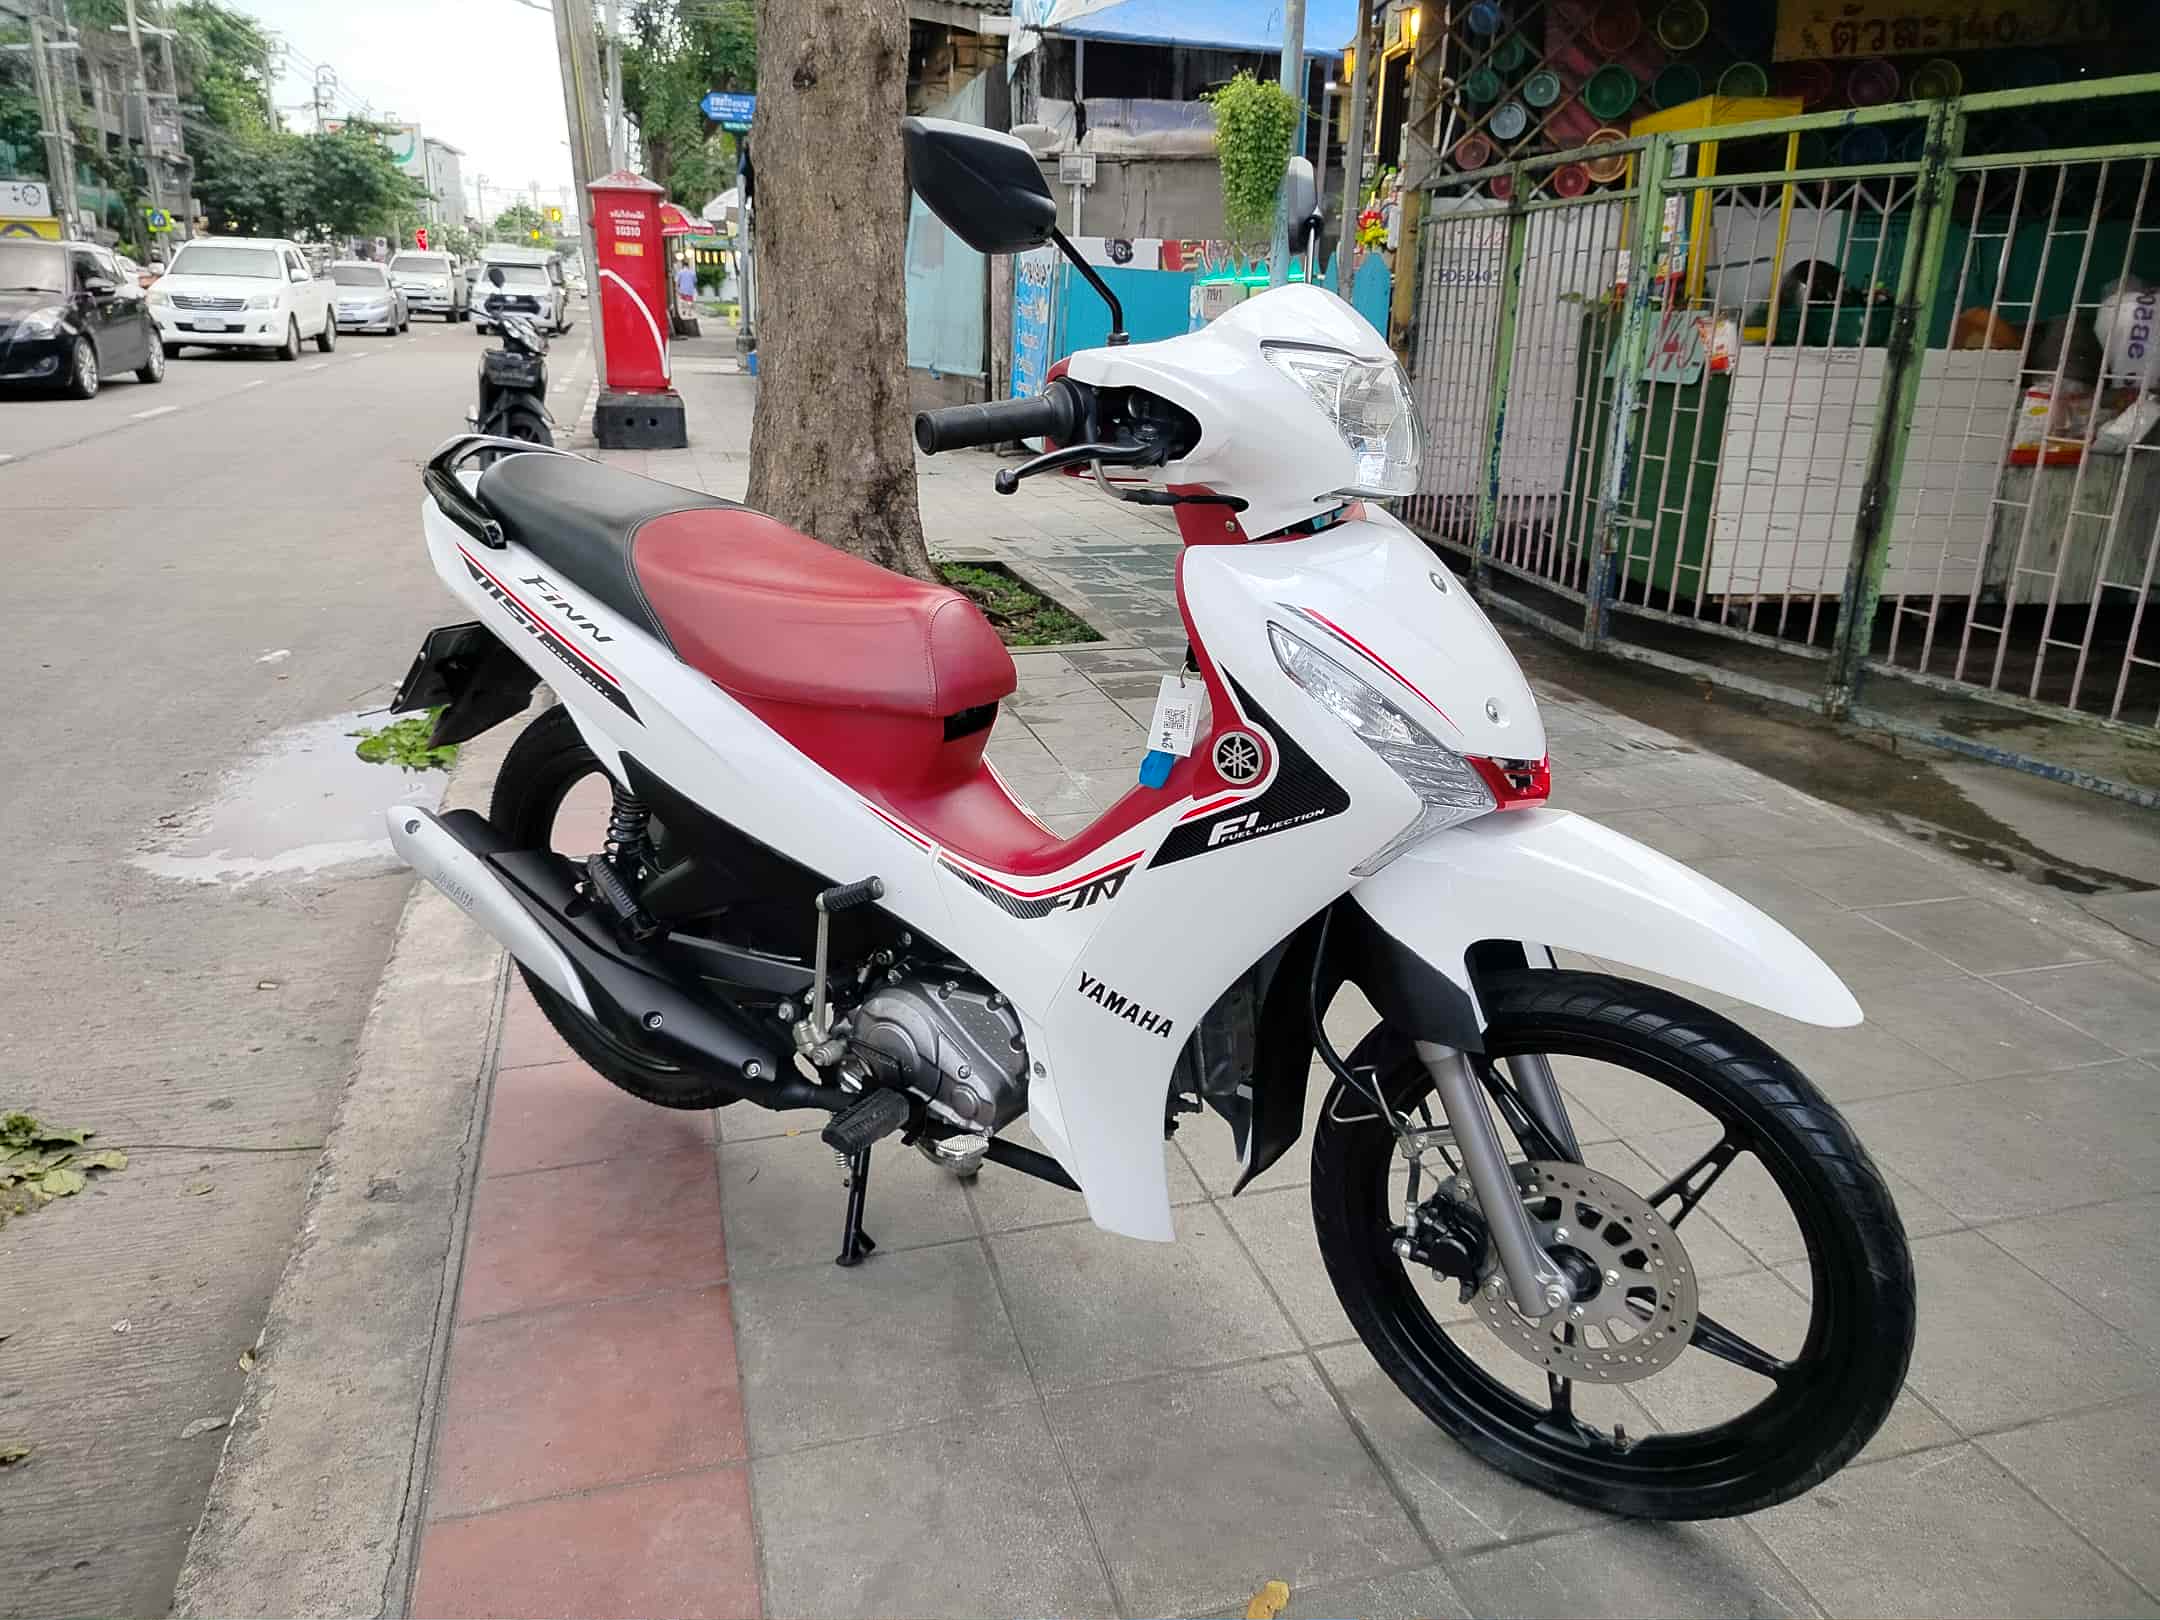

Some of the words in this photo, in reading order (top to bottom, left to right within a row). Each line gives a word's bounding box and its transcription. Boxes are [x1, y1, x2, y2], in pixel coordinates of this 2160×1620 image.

[1221, 829, 1254, 843] FUEL
[1255, 808, 1326, 834] INJECTION
[1078, 970, 1174, 1038] YAMAHA
